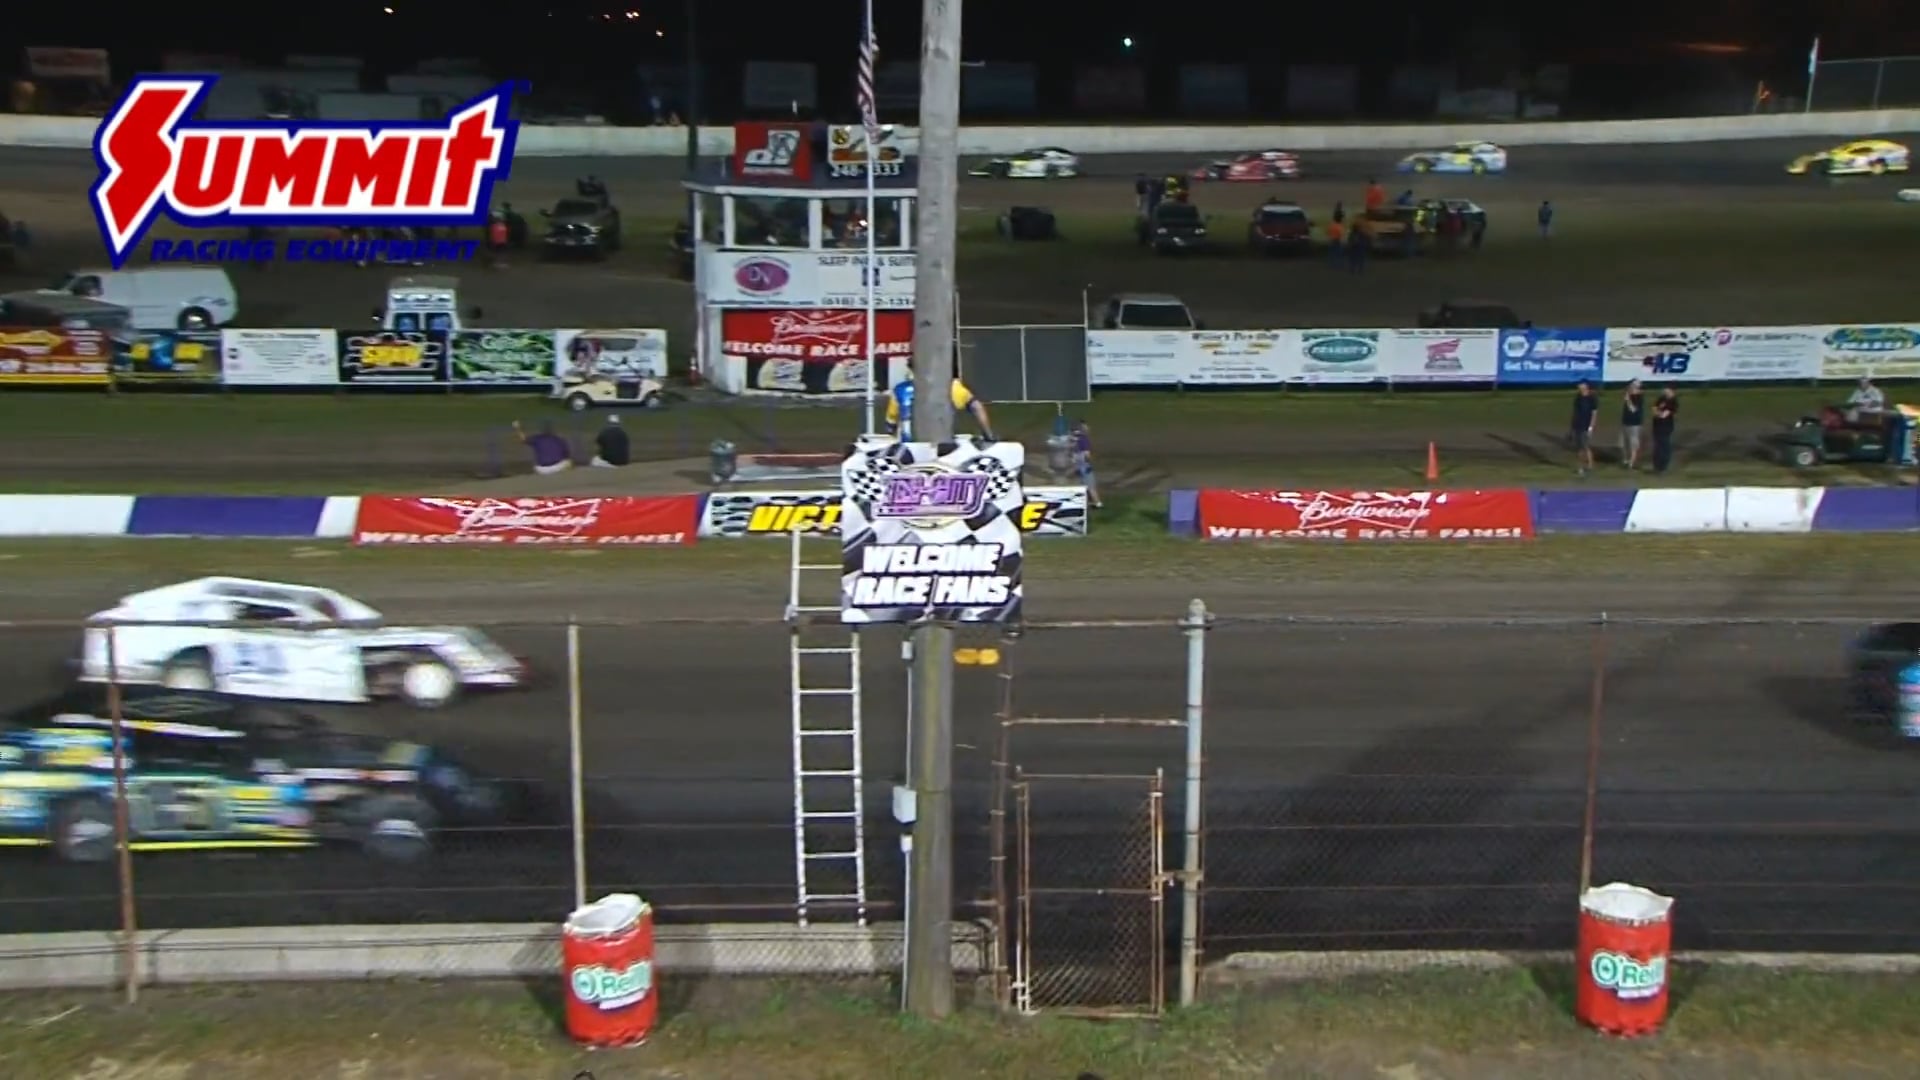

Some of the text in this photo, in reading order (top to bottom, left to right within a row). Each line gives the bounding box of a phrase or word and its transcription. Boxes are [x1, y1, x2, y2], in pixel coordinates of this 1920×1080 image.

[810, 344, 860, 356] RACE
[1523, 361, 1541, 370] The
[1543, 361, 1567, 370] Good
[747, 505, 843, 531] VICT
[1294, 501, 1431, 520] Budweiser
[1209, 526, 1347, 538] WELCOME
[1359, 529, 1428, 538] RACE
[863, 545, 1001, 573] WELCOME
[853, 576, 1011, 604] RACE FANS
